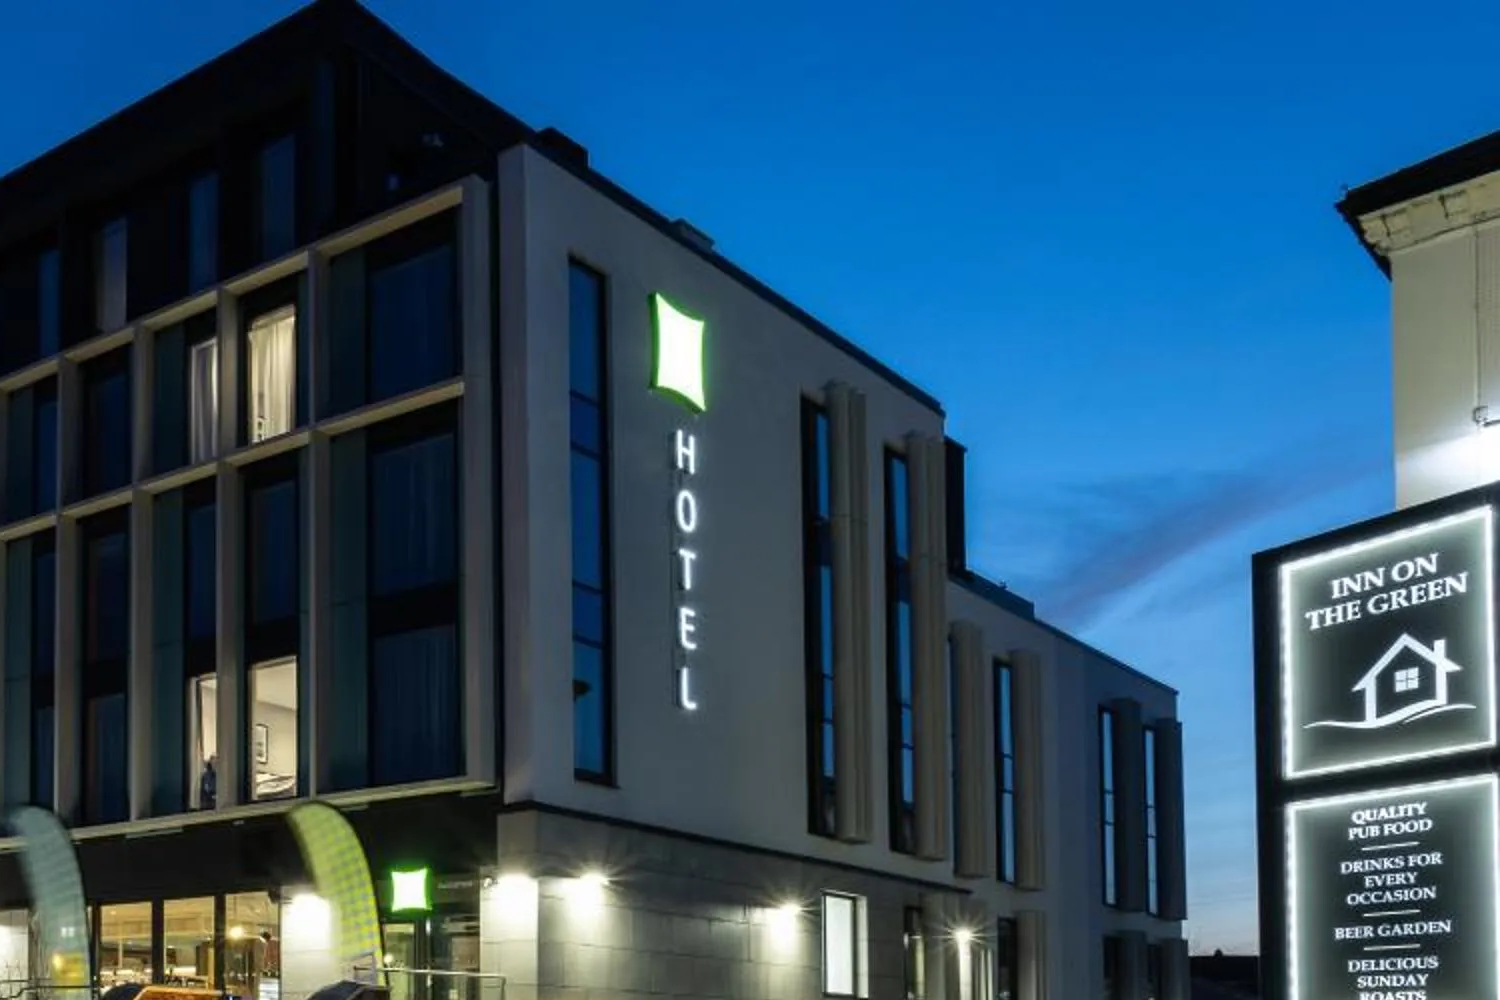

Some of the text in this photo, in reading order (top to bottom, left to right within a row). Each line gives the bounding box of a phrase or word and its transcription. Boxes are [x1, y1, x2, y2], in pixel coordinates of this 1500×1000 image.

[674, 428, 698, 711] HOTEL
[1331, 552, 1439, 599] INN ON
[1304, 571, 1468, 631] THE GREEN
[1351, 801, 1427, 825] QUALITY
[1348, 818, 1433, 841] PUB FOOD
[1340, 851, 1443, 874] DRINKS FOR
[1364, 871, 1417, 888] EVERY
[1346, 885, 1437, 905] OCCASION
[1334, 919, 1452, 940] BEER GARDEN
[1347, 955, 1439, 973] DELICIOUS
[1357, 973, 1428, 989] SUNDAY
